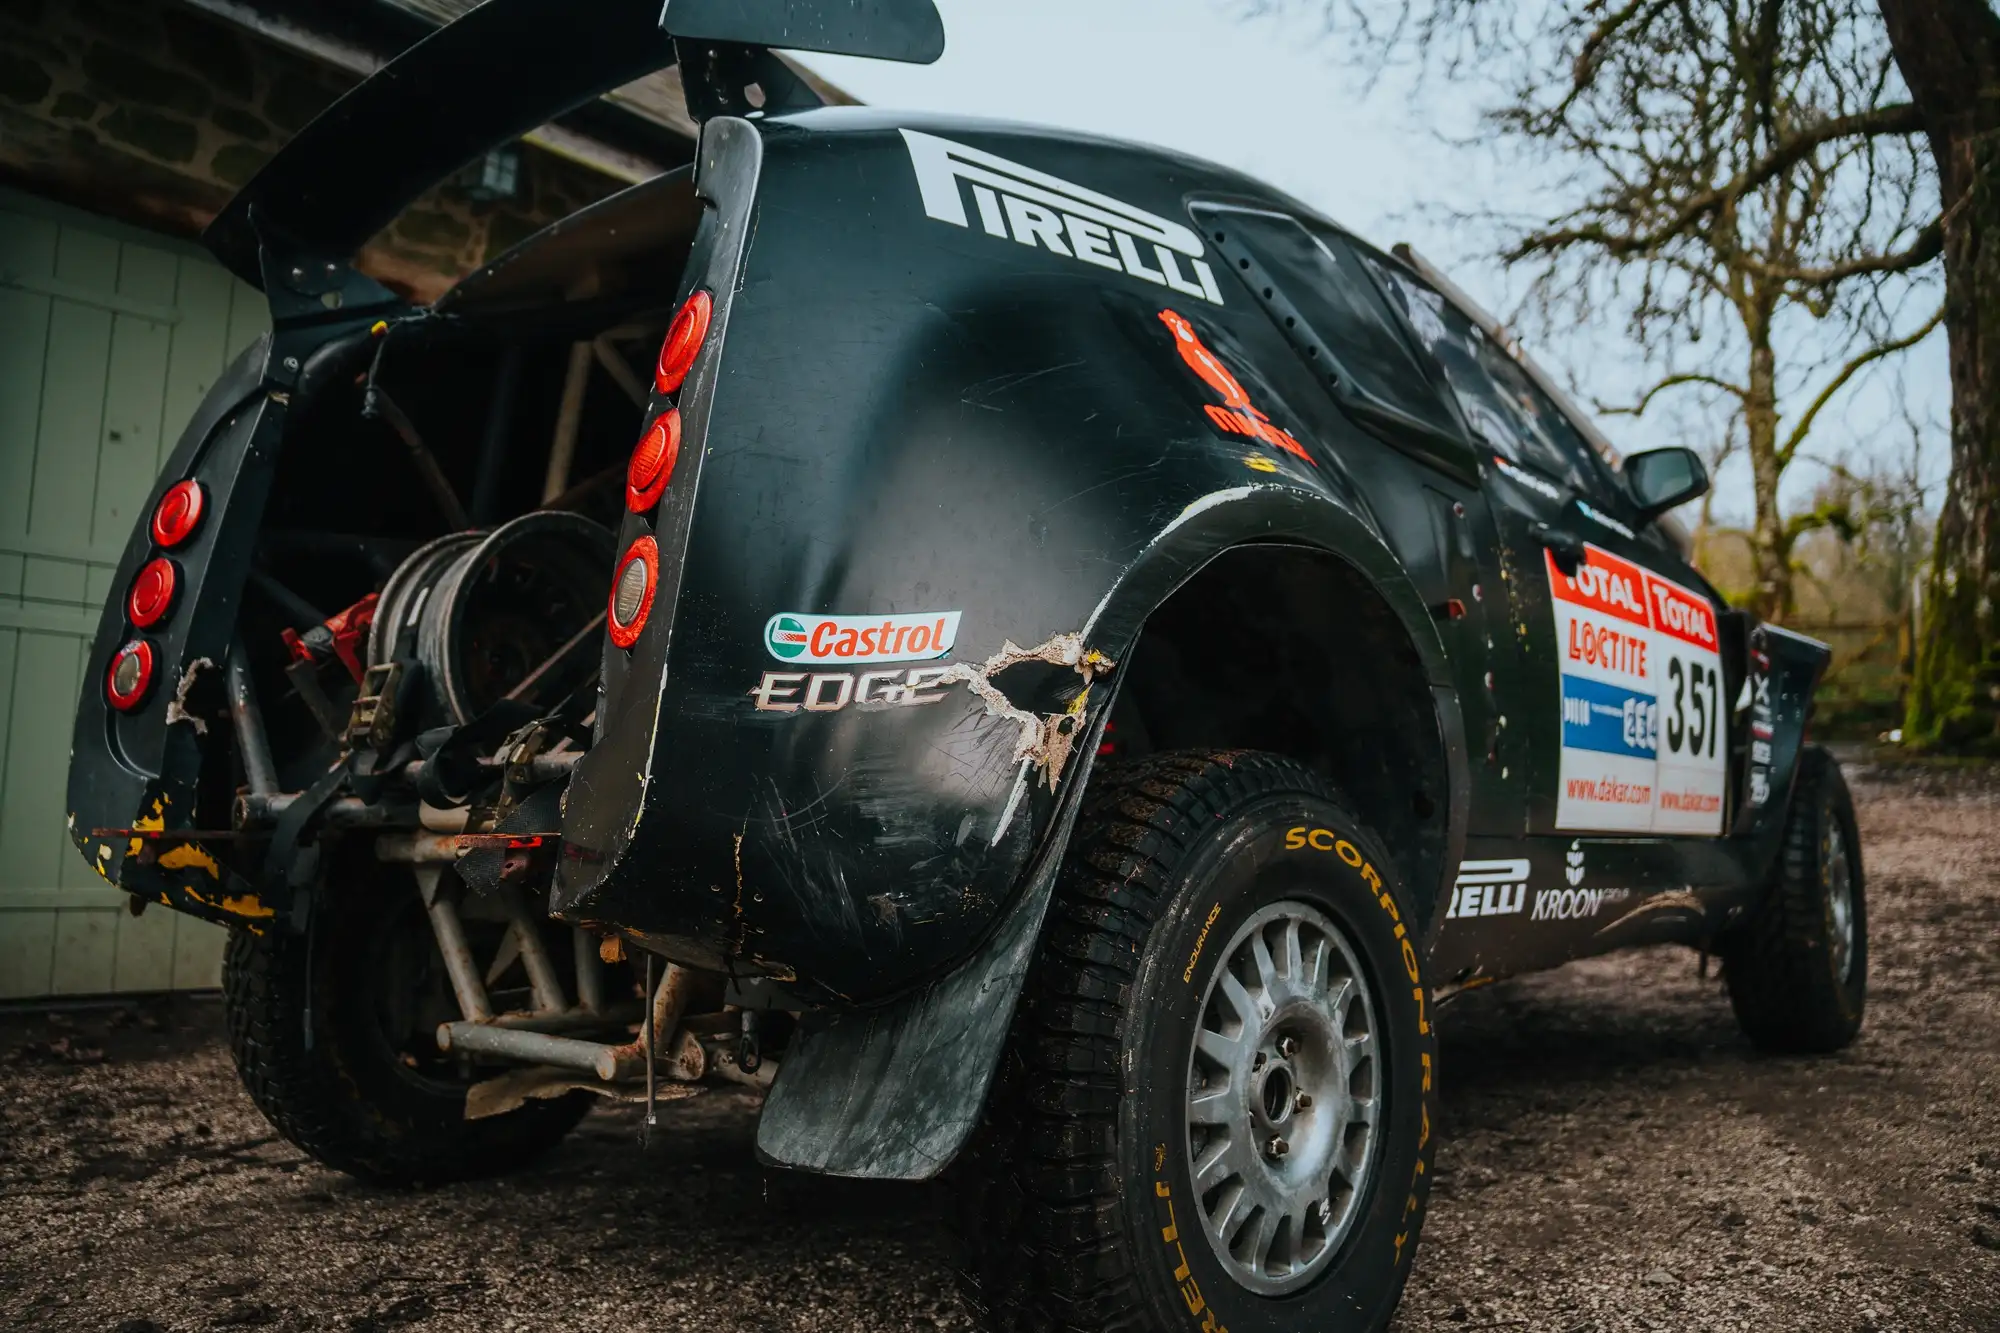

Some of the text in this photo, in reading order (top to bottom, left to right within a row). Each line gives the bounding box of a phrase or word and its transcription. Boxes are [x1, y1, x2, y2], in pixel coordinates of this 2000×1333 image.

[899, 128, 1224, 305] PIRELLI
[810, 617, 946, 658] Castrol
[1651, 583, 1713, 643] TOTAL
[1568, 618, 1647, 678] LOCTITE
[746, 664, 954, 712] EDGE
[1667, 656, 1716, 759] 351
[1567, 775, 1651, 804] www.dakar.com
[1285, 827, 1429, 1035] SCORPION
[1531, 888, 1604, 920] KROON
[1183, 902, 1222, 984] ENDURANCE
[1156, 1181, 1228, 1333] RELLI
